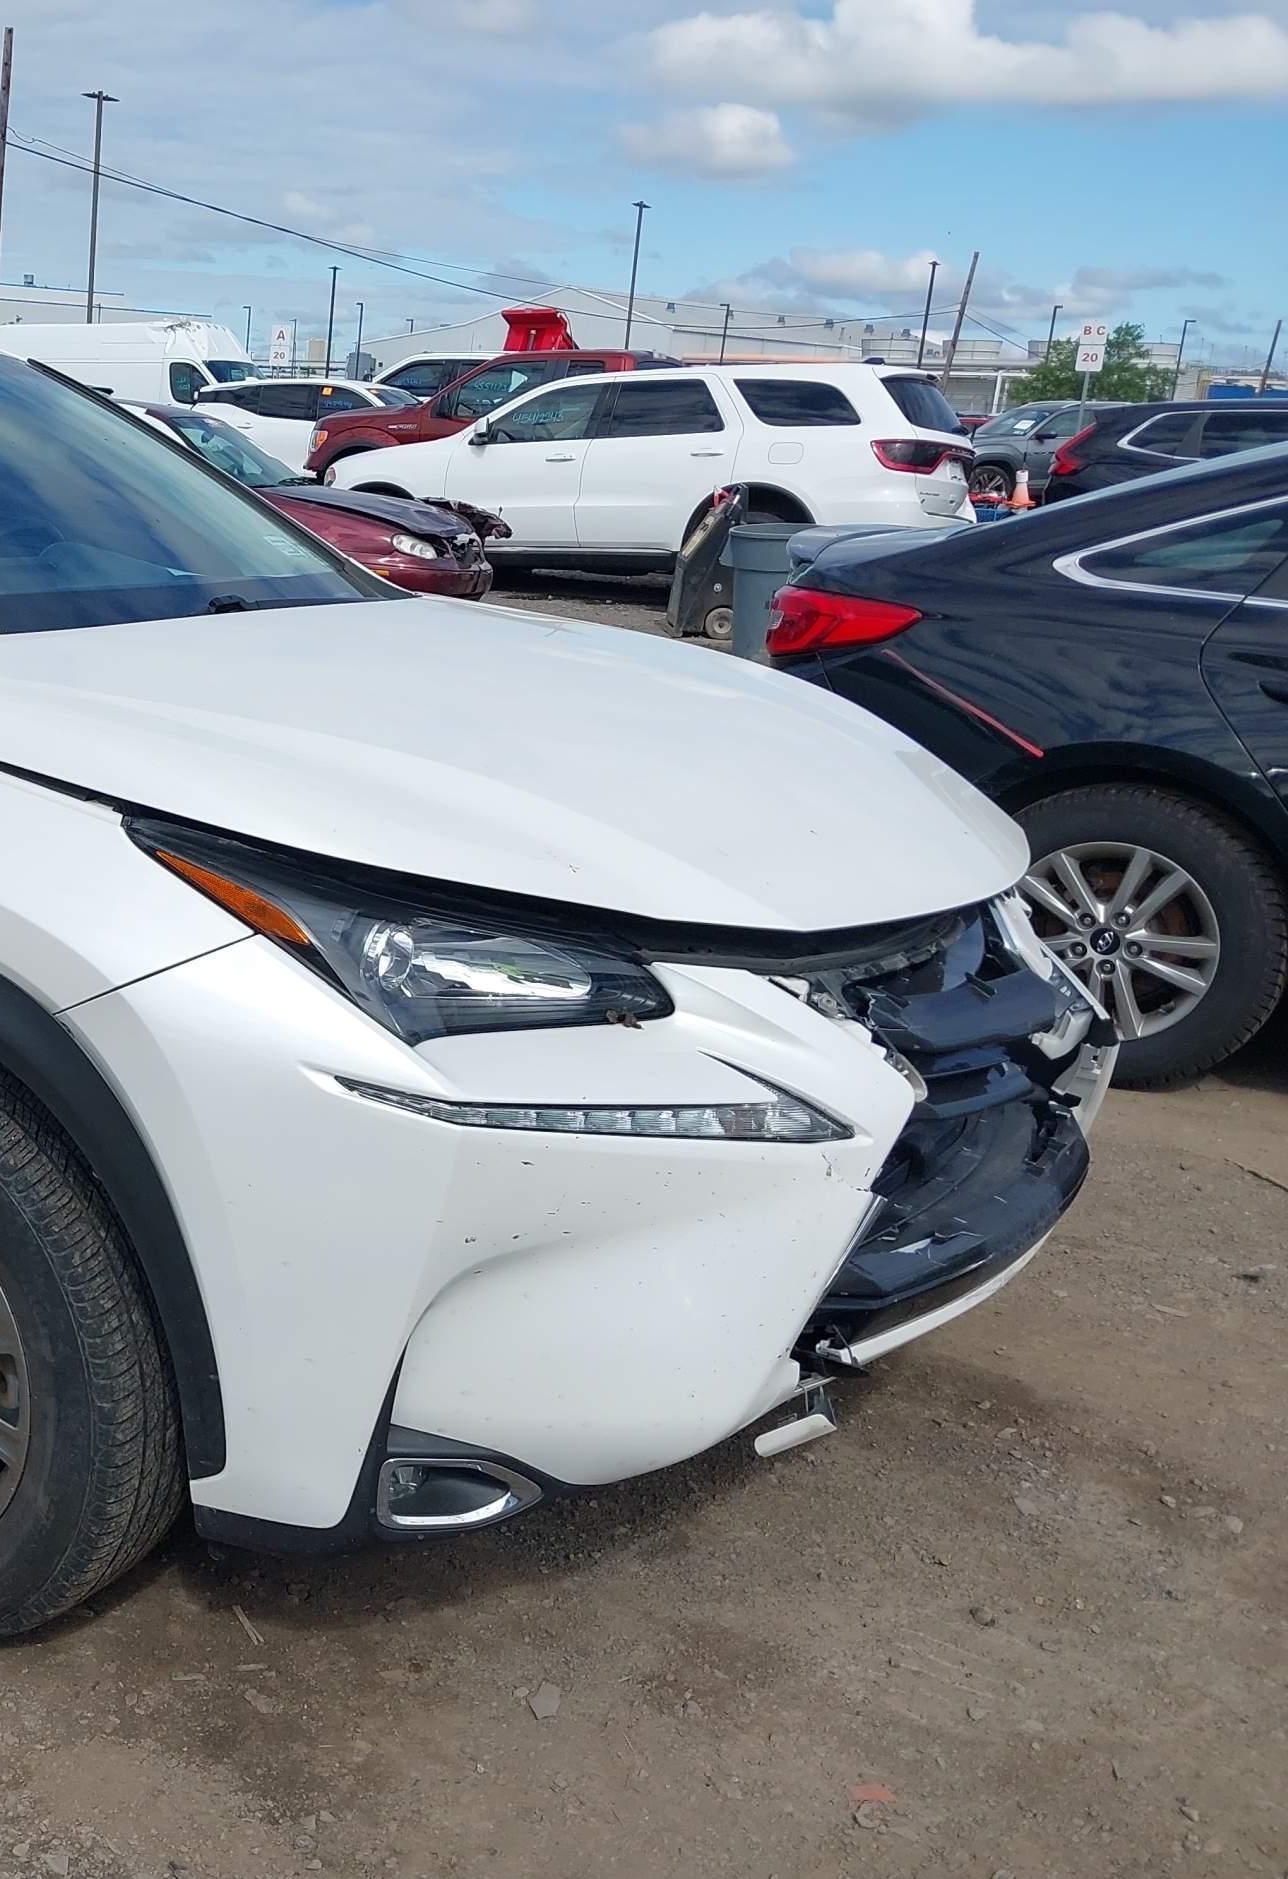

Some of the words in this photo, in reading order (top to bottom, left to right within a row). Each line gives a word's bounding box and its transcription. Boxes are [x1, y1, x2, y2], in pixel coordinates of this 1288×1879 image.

[276, 329, 286, 341] A
[1084, 325, 1092, 335] B
[1097, 325, 1106, 335] C
[272, 351, 286, 360] 20
[1082, 352, 1098, 362] 20
